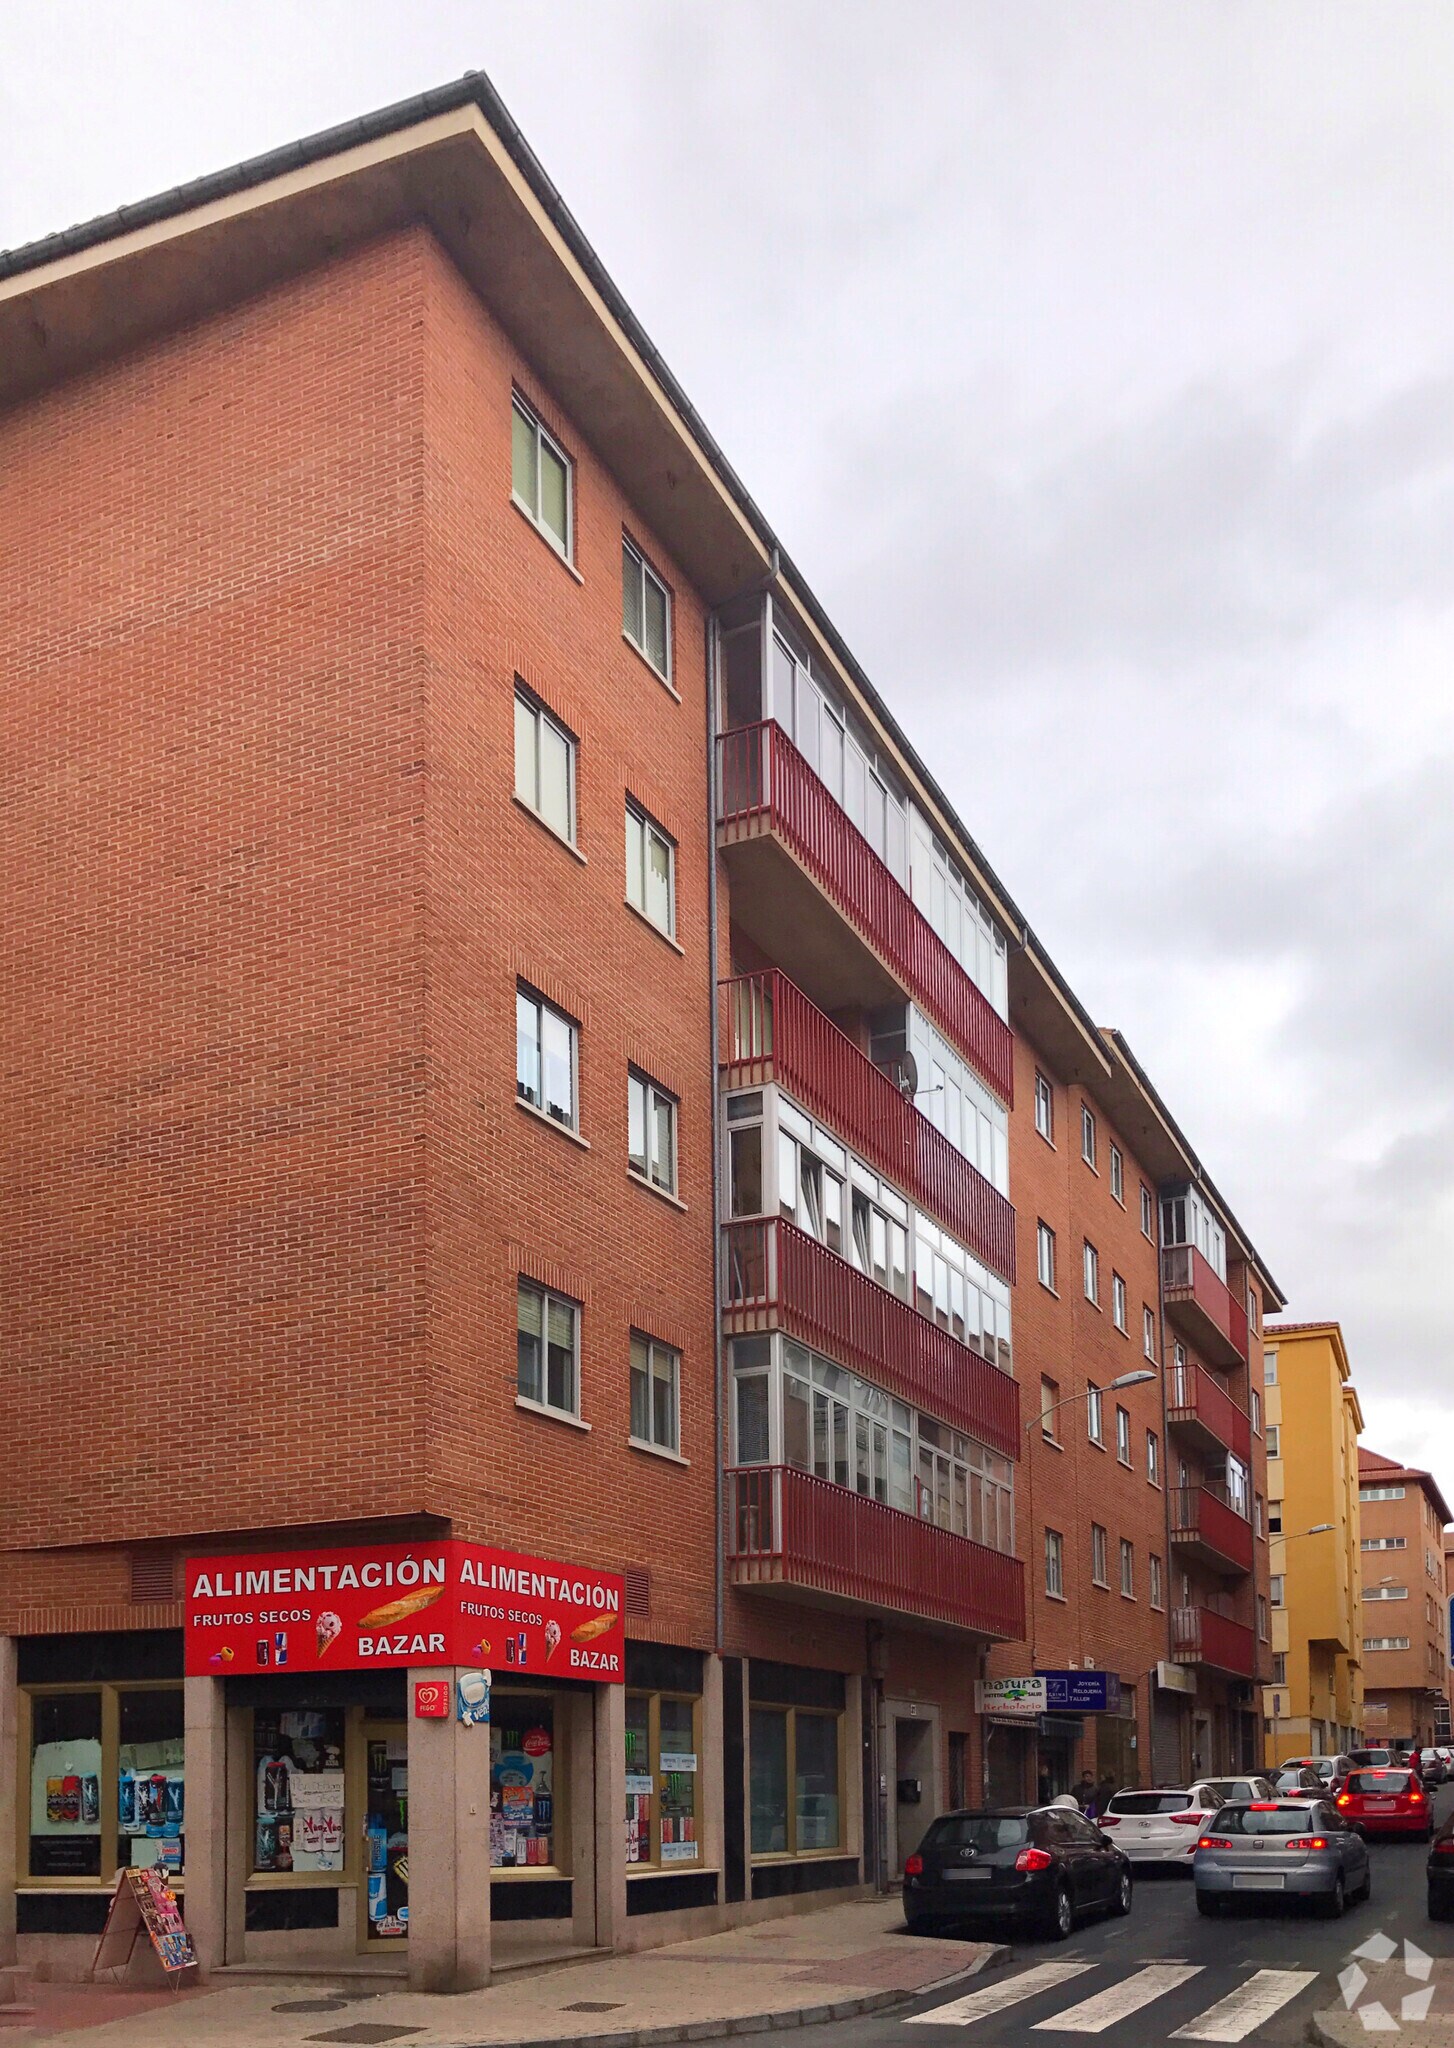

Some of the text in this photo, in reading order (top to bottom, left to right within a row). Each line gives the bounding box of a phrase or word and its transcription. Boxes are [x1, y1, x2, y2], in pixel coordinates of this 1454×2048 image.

[192, 1554, 446, 1599] ALIMENTACIÓN
[459, 1559, 619, 1611] ALIMENTACIÓN
[193, 1609, 312, 1627] FRUTOS SECOS
[460, 1601, 543, 1626] FRUTOS SECOS
[358, 1633, 446, 1657] BAZAR
[570, 1649, 619, 1672] BAZAR
